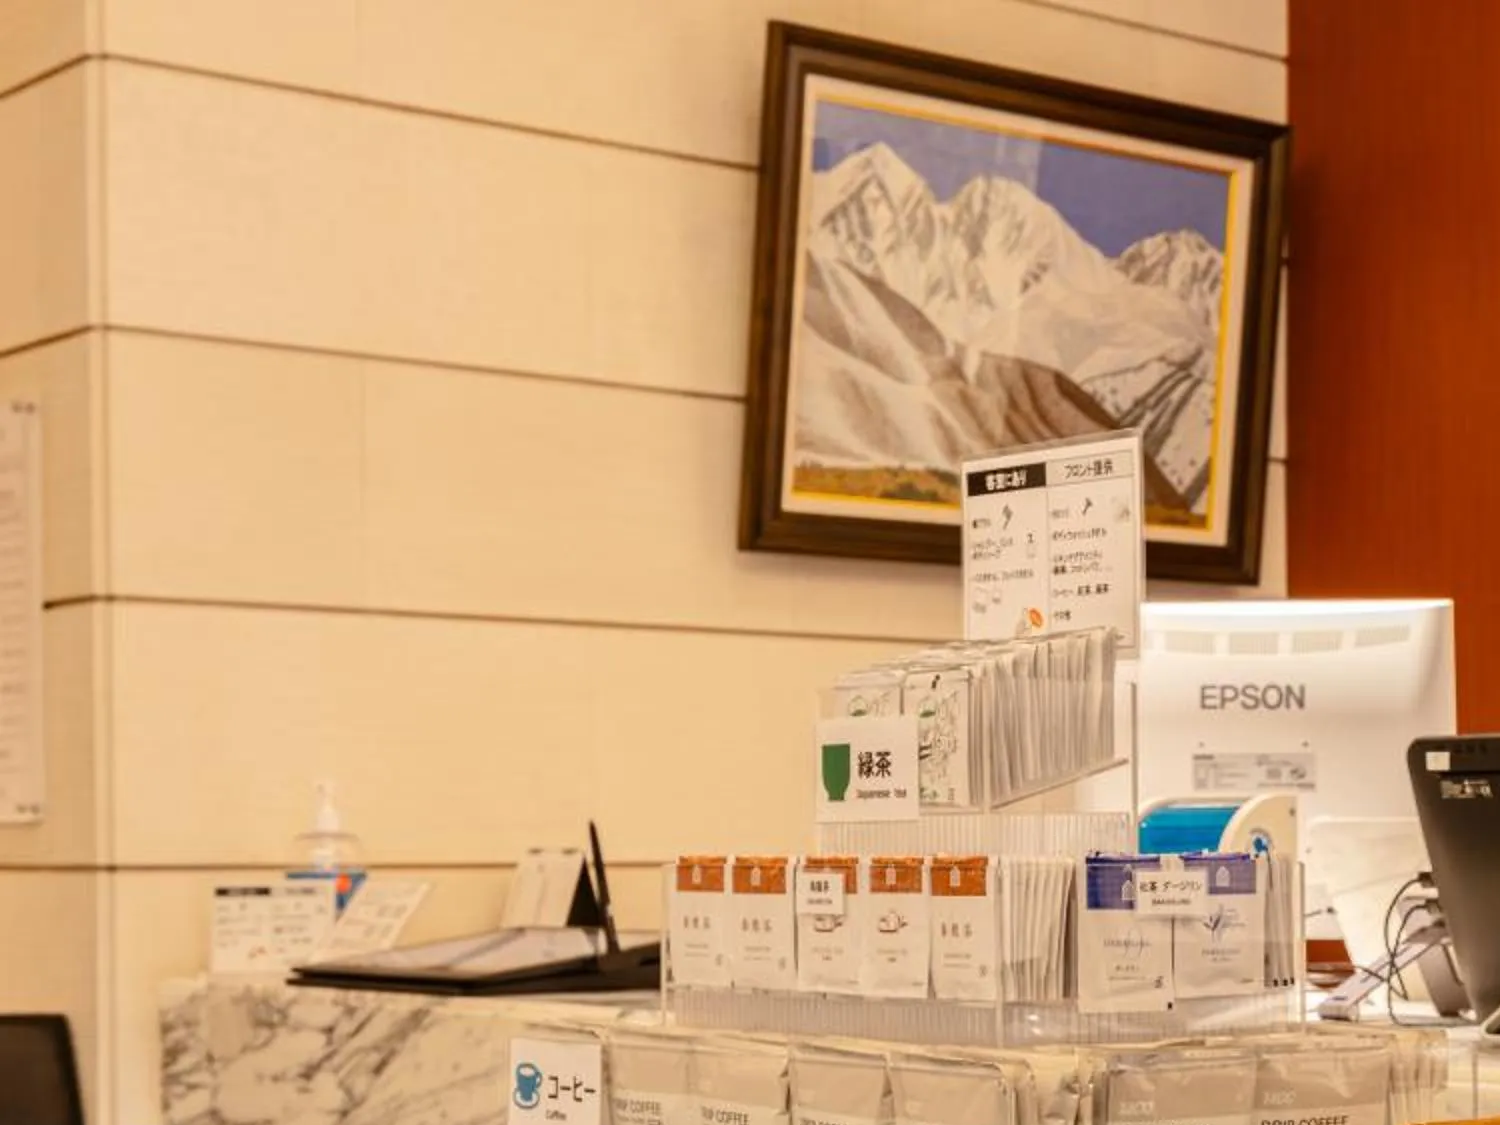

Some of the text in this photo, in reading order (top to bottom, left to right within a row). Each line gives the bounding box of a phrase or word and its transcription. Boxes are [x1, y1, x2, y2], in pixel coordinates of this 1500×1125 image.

[1200, 684, 1306, 710] EPSON
[857, 751, 892, 778] 緑茶
[547, 1074, 597, 1103] コーヒー
